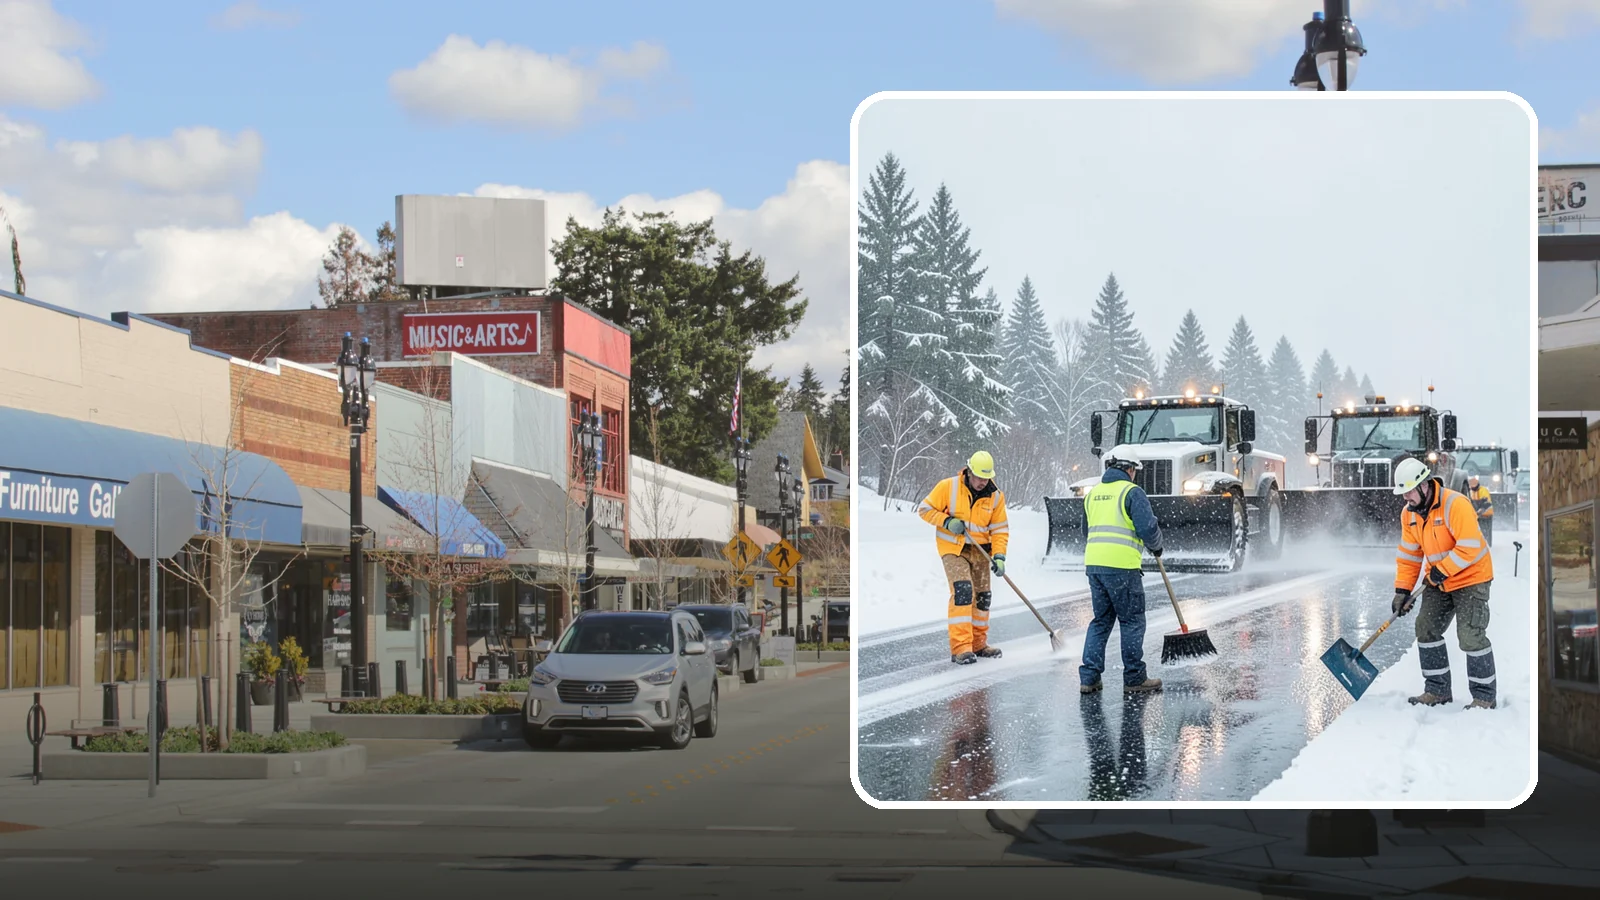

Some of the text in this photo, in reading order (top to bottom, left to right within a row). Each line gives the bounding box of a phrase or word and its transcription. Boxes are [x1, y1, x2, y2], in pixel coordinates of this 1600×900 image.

[409, 323, 520, 349] MUSIC&ARTS
[0, 471, 122, 519] Furniture Gal
